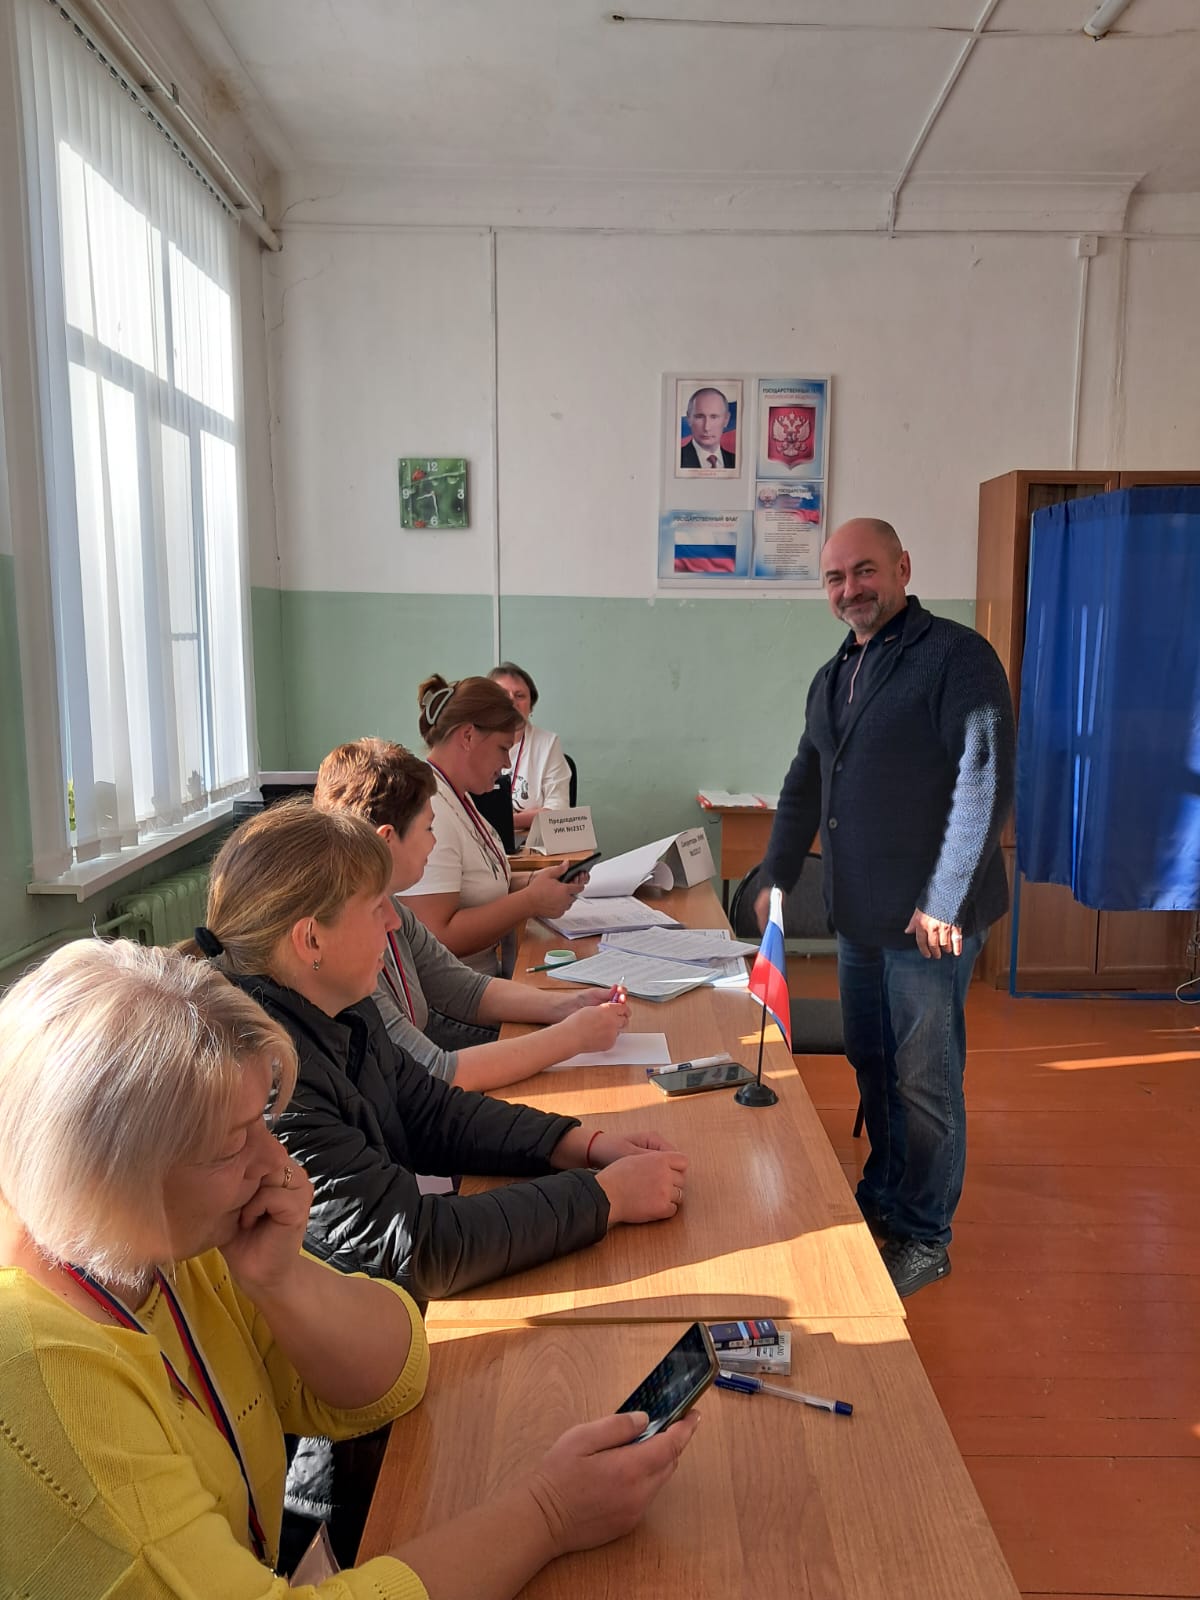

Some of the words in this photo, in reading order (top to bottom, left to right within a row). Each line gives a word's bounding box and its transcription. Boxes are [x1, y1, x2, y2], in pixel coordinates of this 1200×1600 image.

[427, 461, 438, 472] 12
[402, 489, 410, 499] 9
[457, 489, 464, 499] 3
[431, 516, 438, 525] 6
[548, 815, 588, 825] Председатель
